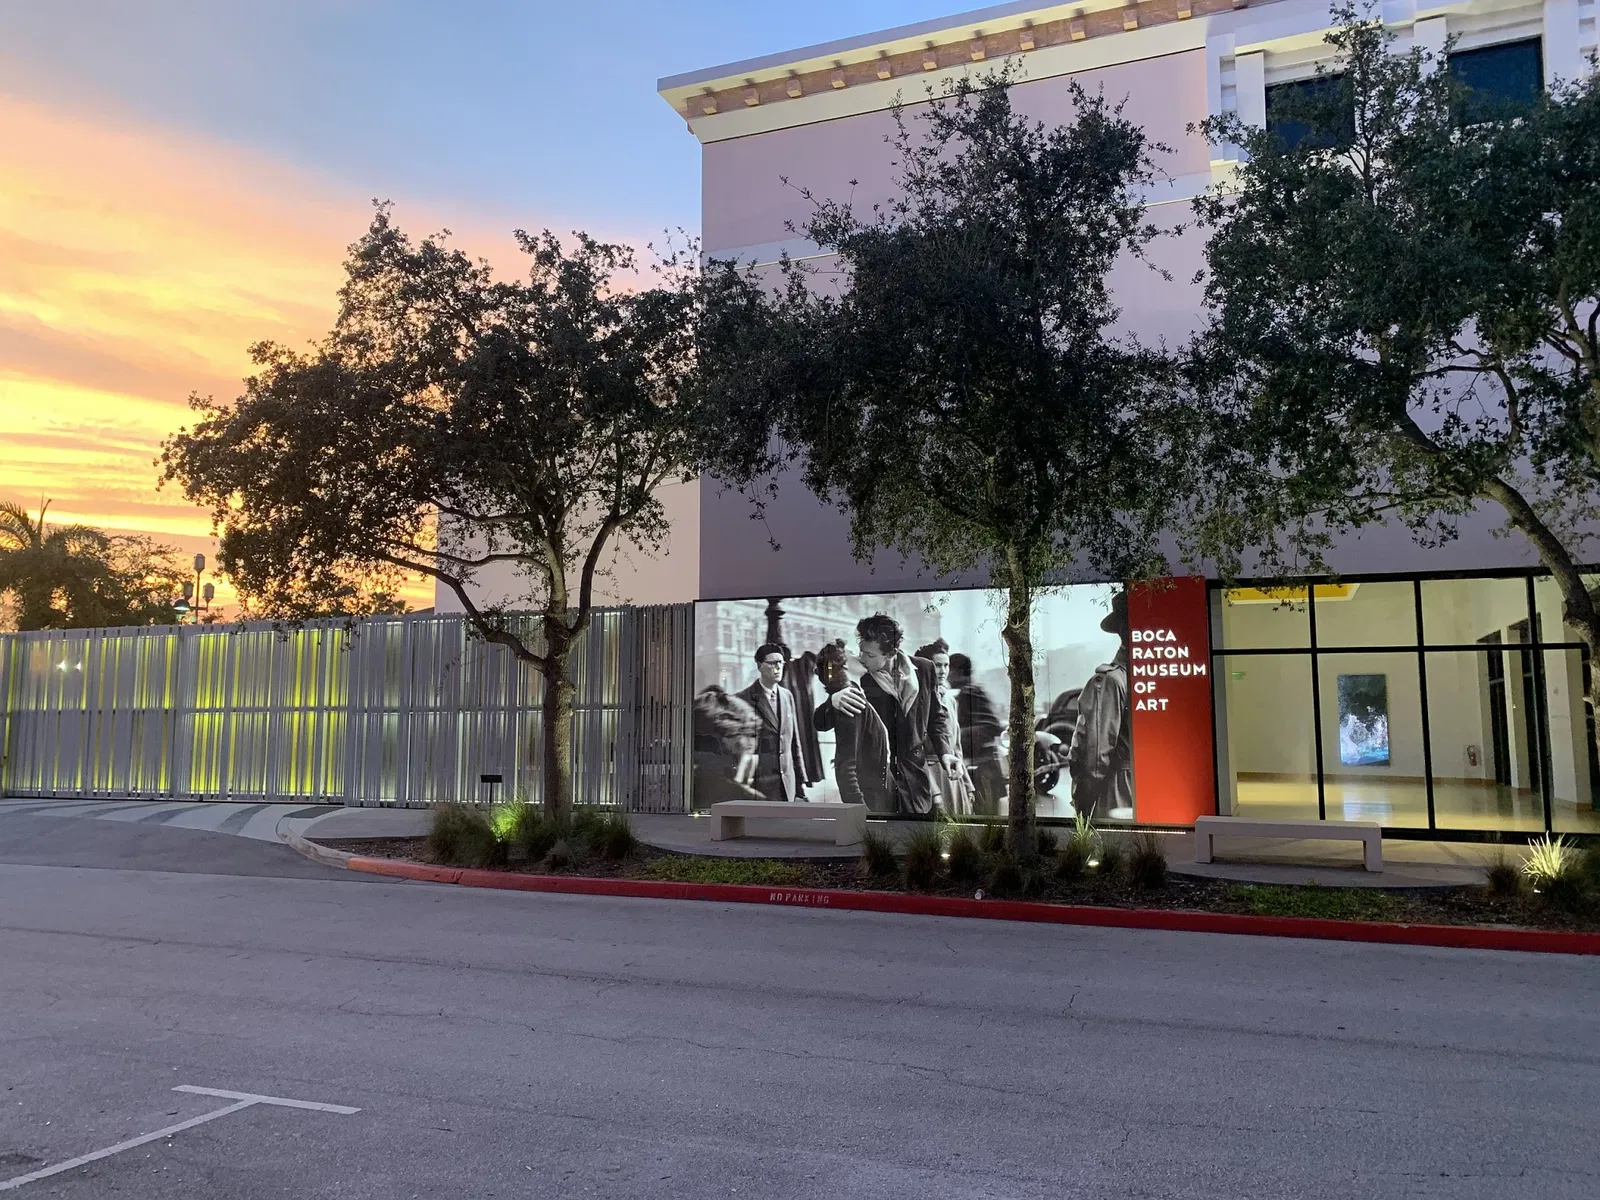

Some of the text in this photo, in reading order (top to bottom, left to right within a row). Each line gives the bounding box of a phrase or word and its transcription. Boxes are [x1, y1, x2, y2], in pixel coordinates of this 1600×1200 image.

[1131, 630, 1177, 642] BOCA
[1132, 646, 1189, 659] RATON
[1133, 663, 1206, 676] MUSEUM
[1134, 681, 1156, 694] OF
[1135, 698, 1169, 711] ART
[770, 892, 829, 904] NO PARKING
